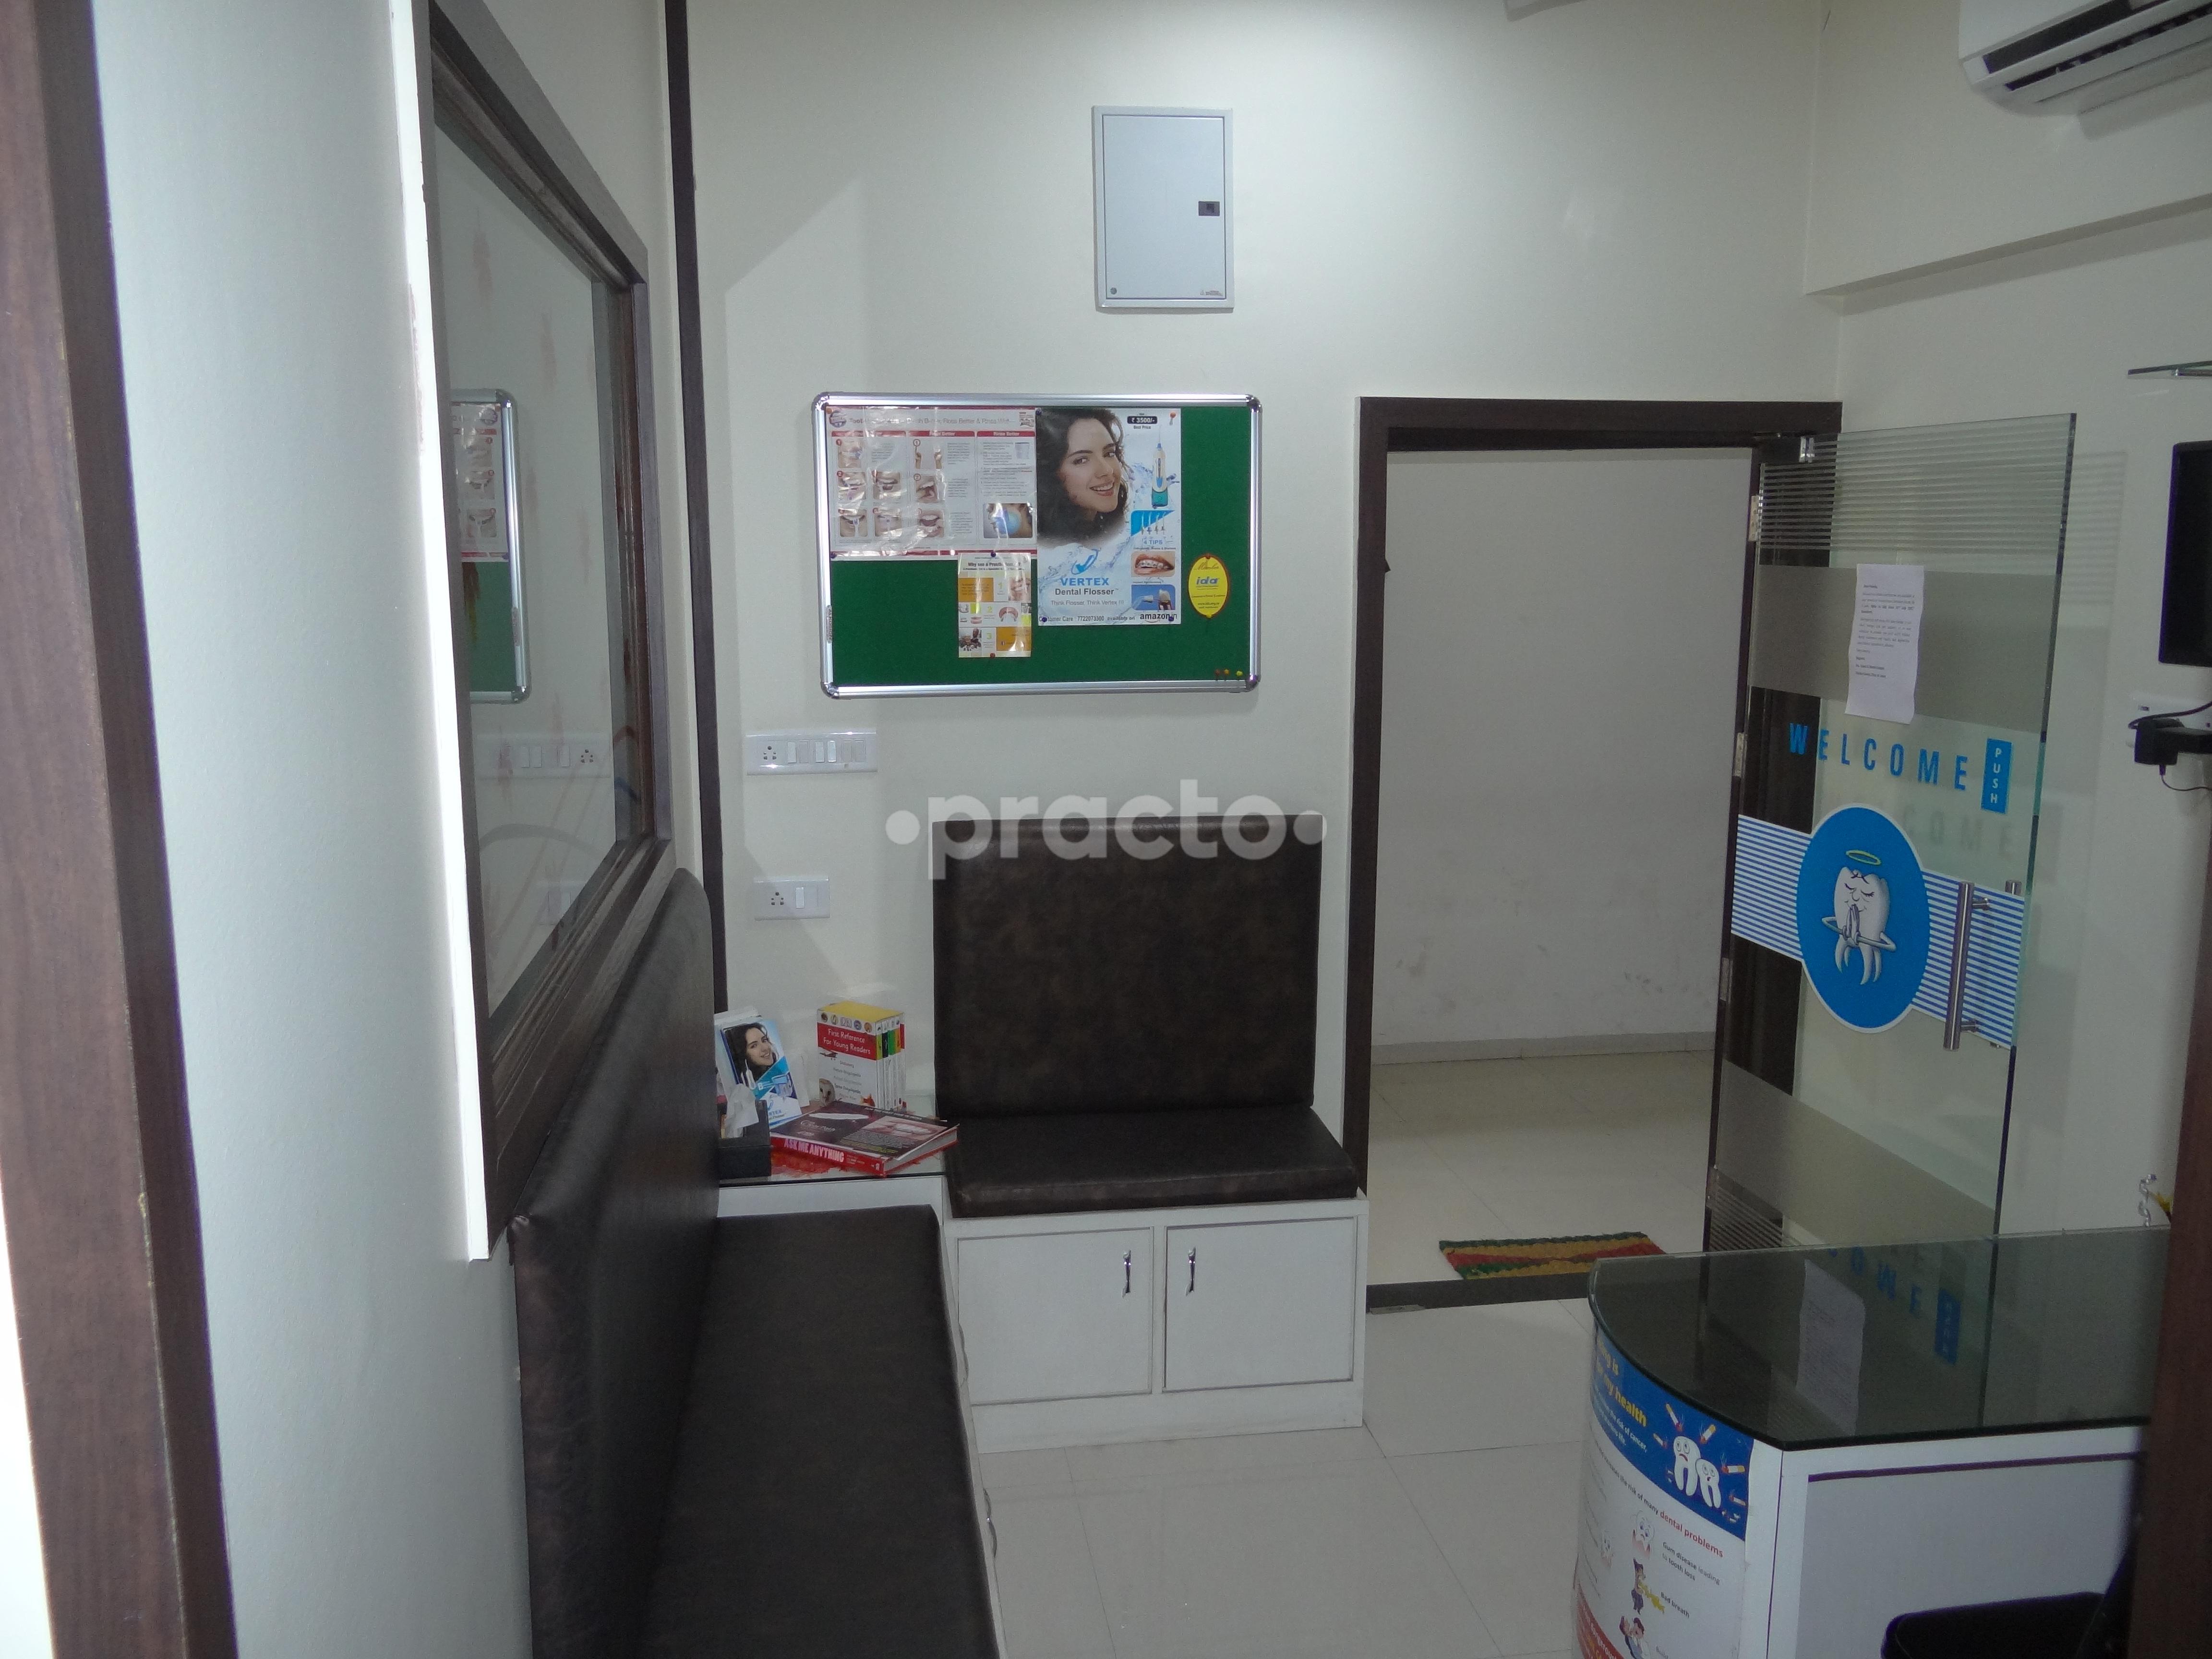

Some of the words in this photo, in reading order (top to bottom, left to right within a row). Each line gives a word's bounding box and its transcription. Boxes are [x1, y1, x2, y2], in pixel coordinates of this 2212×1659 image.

[1060, 578, 1109, 586] VERTEX
[1789, 722, 1968, 791] WELCOME
[1990, 747, 2002, 804] PUSH
[828, 1028, 840, 1037] First
[841, 1031, 865, 1043] Reference
[833, 1039, 849, 1051] Young
[850, 1044, 871, 1054] Readers
[784, 1138, 798, 1150] ASK
[798, 1142, 809, 1153] ME
[809, 1144, 845, 1163] ANYTHING
[1615, 1385, 1647, 1427] health
[1630, 1432, 1647, 1453] cancer,
[1628, 1482, 1637, 1496] risk
[1637, 1492, 1644, 1501] of
[1644, 1498, 1659, 1515] many
[1660, 1511, 1683, 1532] dental
[1684, 1528, 1724, 1558] problems
[1663, 1541, 1675, 1555] Gum
[1676, 1552, 1697, 1570] disease
[1698, 1566, 1720, 1586] leading
[1669, 1558, 1683, 1574] tooth
[1684, 1569, 1695, 1581] loss
[1660, 1591, 1671, 1604] Bad
[1671, 1600, 1690, 1619] breath
